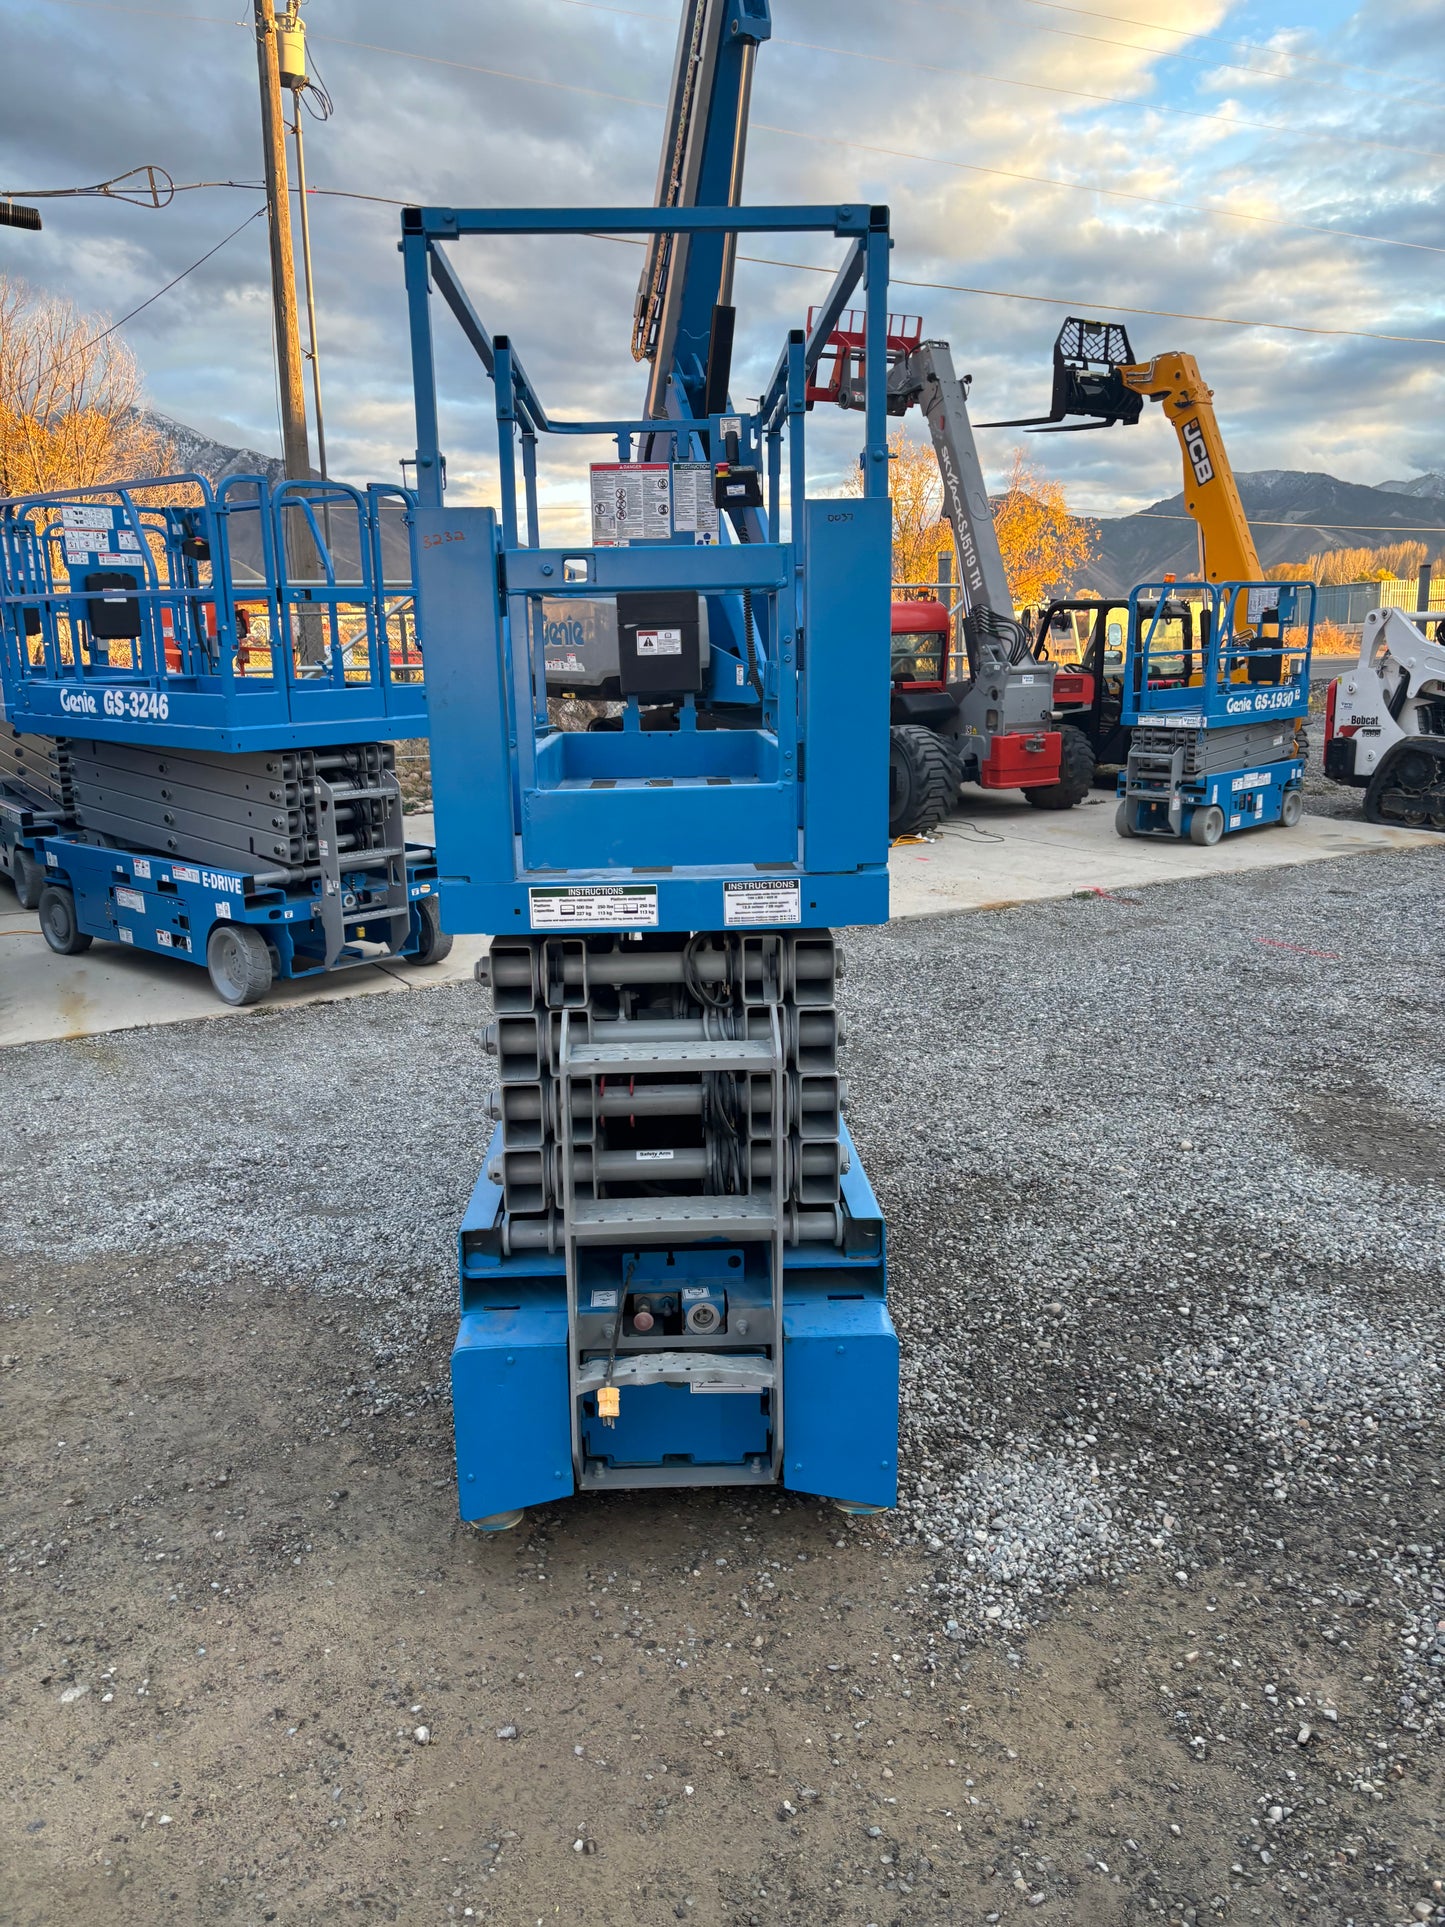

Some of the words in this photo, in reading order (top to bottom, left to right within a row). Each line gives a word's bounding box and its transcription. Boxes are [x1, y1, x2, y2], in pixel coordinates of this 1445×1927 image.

[1183, 422, 1214, 484] JCB
[941, 445, 963, 521] SKYJACK
[957, 520, 977, 568] SJ519
[969, 566, 983, 591] TH
[423, 531, 465, 549] 3232
[60, 688, 98, 714] Genie
[103, 690, 169, 720] GS-3246
[1226, 696, 1252, 713] Genie
[1255, 691, 1294, 710] GS-1930
[1351, 715, 1379, 725] Bobcat
[202, 871, 242, 895] E-DRIVE
[568, 888, 624, 896] INSTRUCTIONS
[728, 881, 795, 890] INSTRUCTIONS
